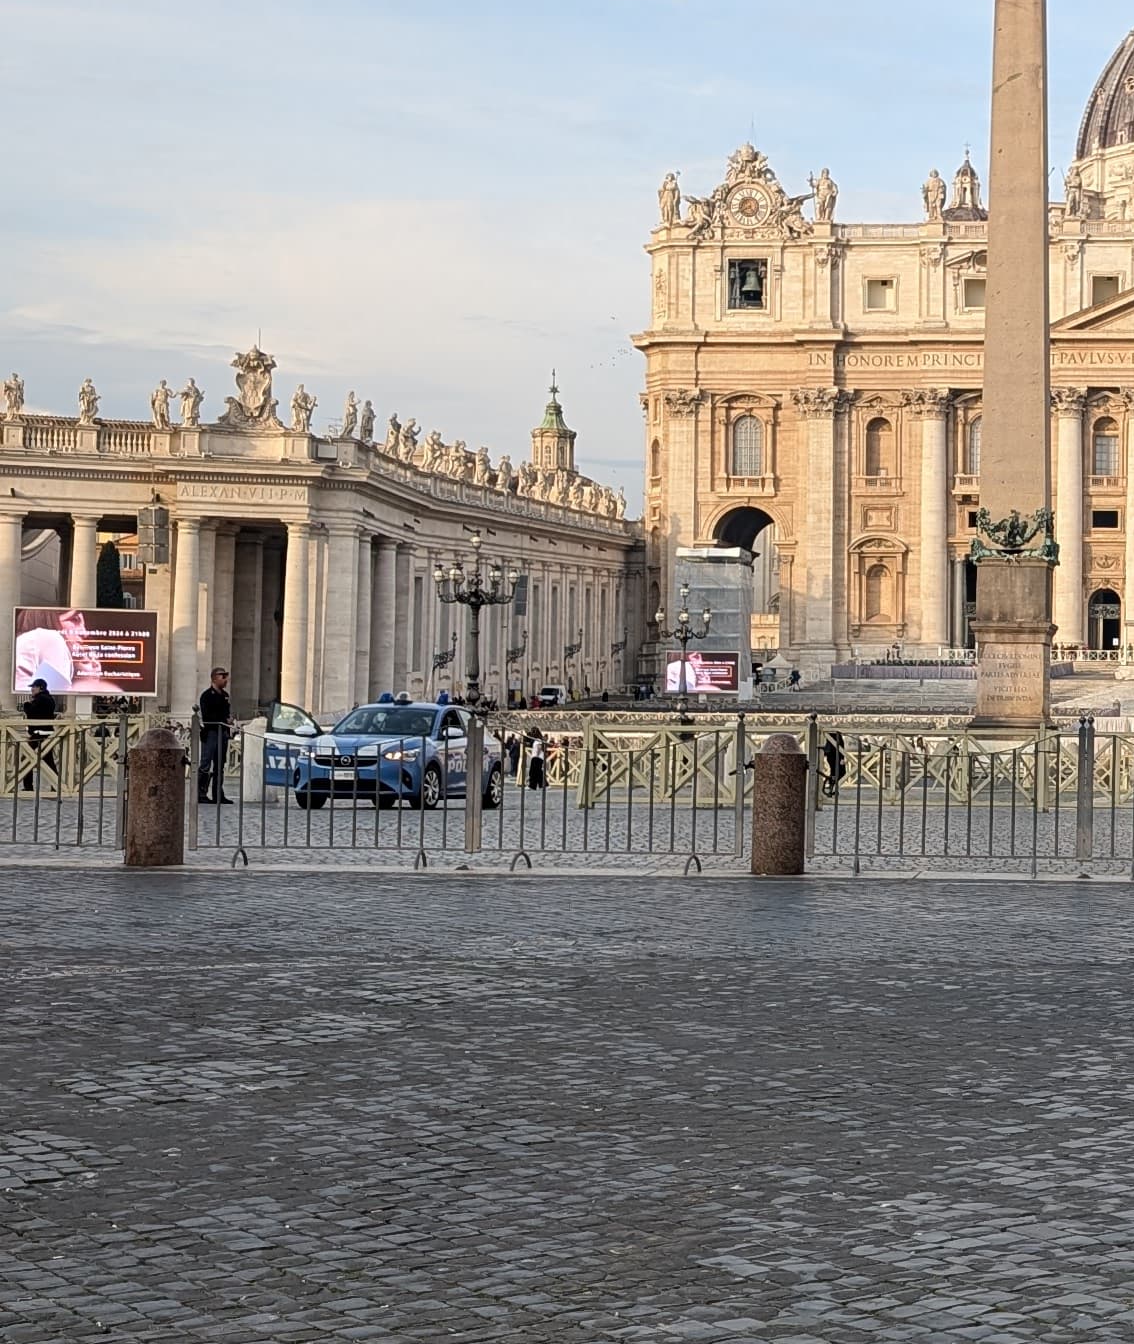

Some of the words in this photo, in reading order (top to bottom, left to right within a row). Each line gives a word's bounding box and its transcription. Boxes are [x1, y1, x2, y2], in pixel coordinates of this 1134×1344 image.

[808, 353, 827, 366] IN
[836, 353, 919, 367] HONOREM
[921, 353, 982, 367] PRINCI
[1060, 352, 1115, 365] PAVLVS
